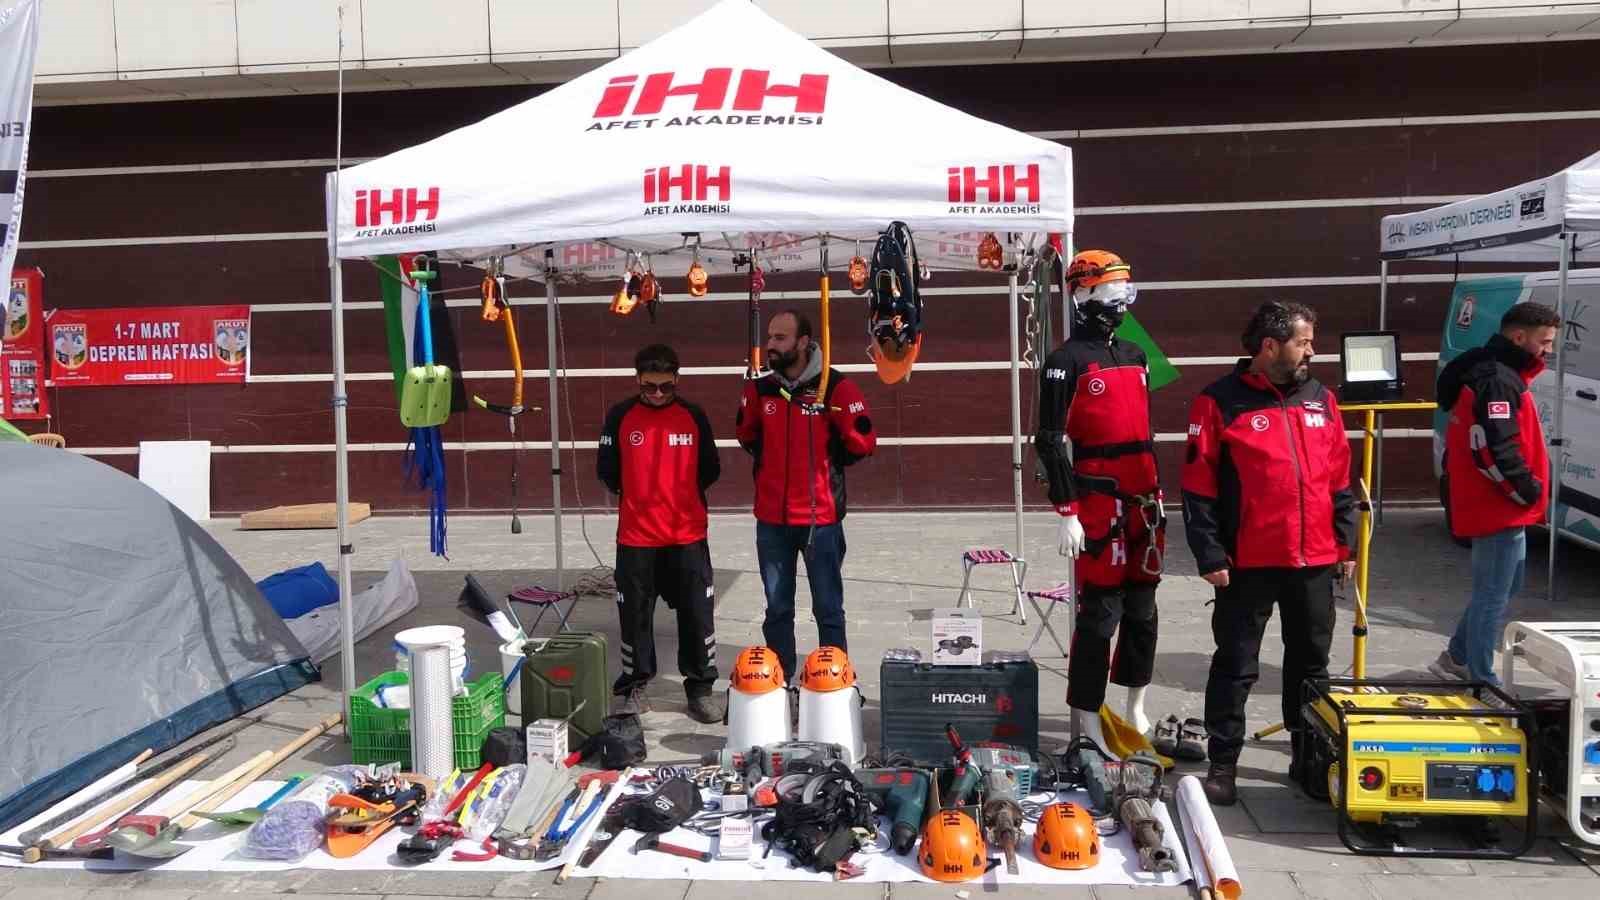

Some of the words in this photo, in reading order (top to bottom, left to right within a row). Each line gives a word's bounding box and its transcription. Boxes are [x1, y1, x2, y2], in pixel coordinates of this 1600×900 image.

[585, 118, 660, 132] AFET
[665, 115, 823, 127] AKADEMİSİ
[643, 205, 671, 215] AFET
[672, 203, 730, 213] AKADEMİSİ
[948, 206, 976, 214] AFET
[979, 204, 1040, 214] AKADEMİSİ
[355, 229, 381, 237] AFET
[381, 223, 437, 236] AKADEMİSİ
[115, 323, 136, 339] 1-7
[140, 322, 180, 339] MART
[90, 344, 148, 362] DEPREM
[152, 342, 213, 361] HAFTASI
[931, 693, 986, 704] HITACHI
